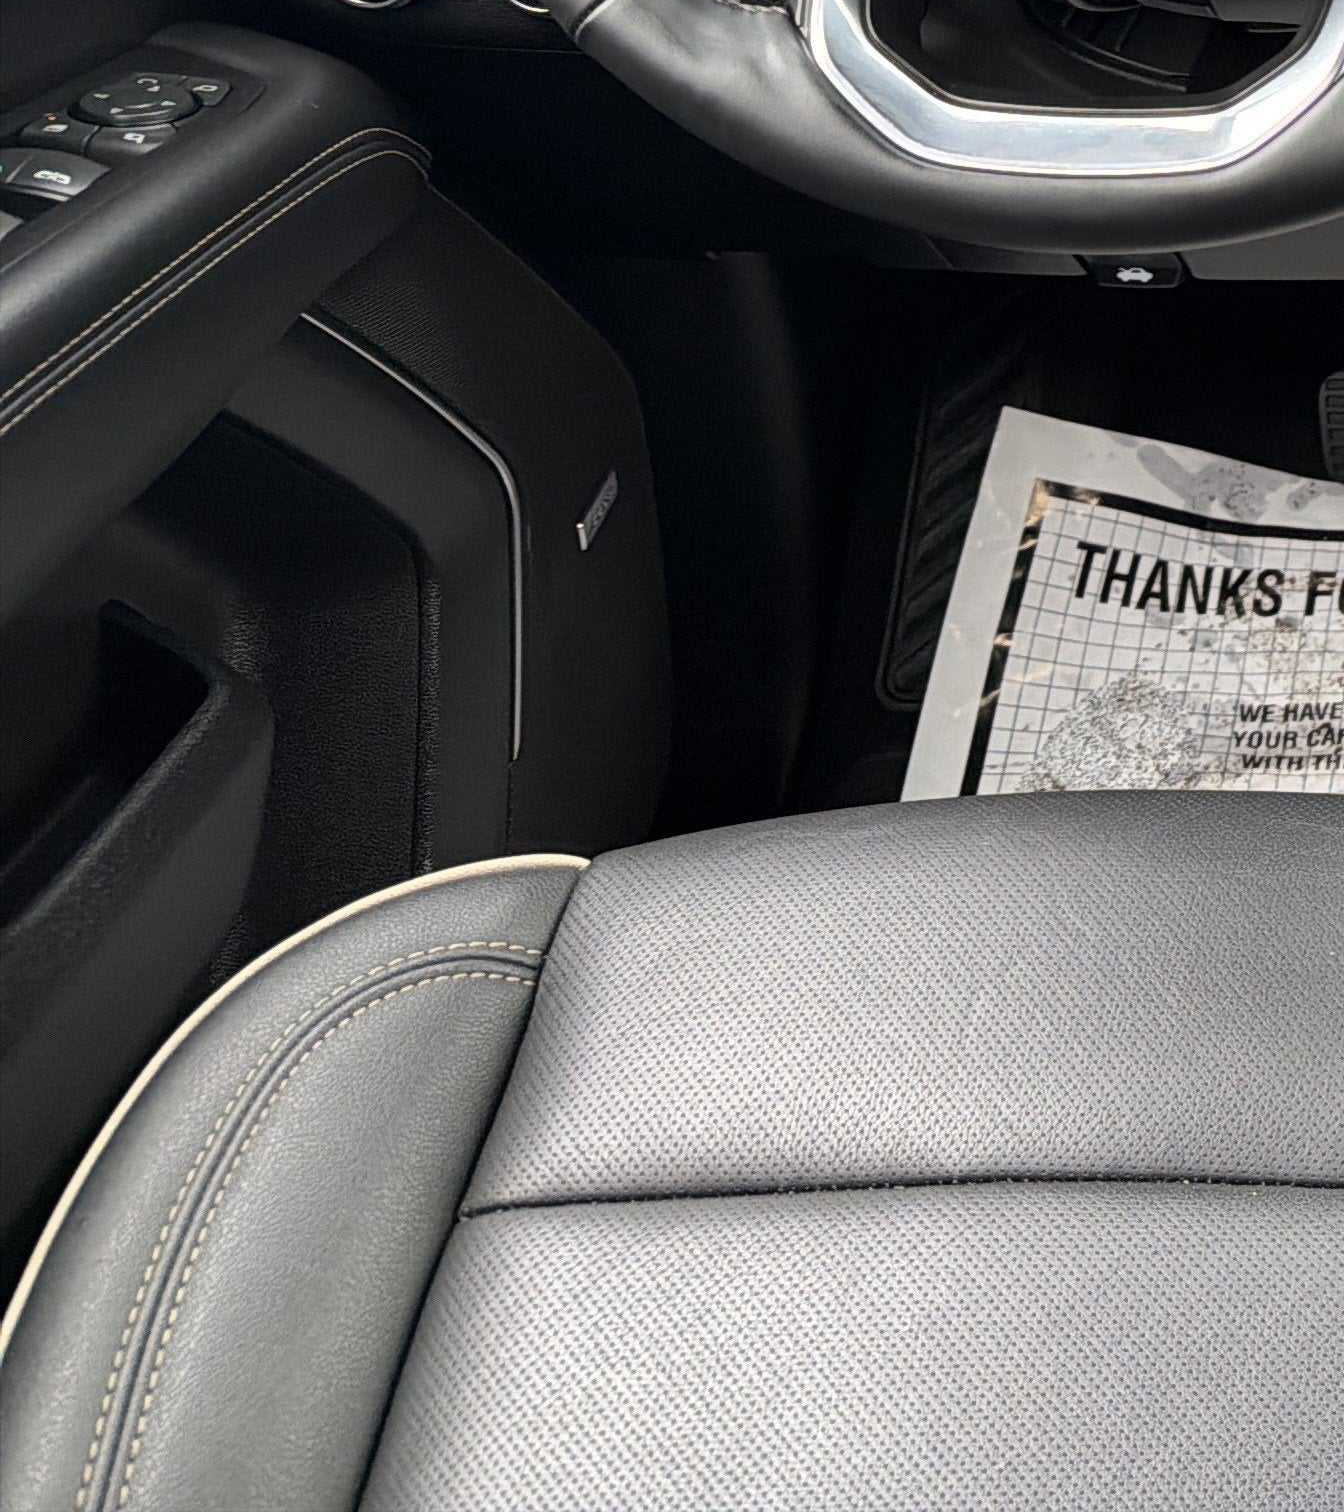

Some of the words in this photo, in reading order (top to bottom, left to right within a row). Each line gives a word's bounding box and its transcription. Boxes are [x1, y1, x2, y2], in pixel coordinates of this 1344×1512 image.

[1073, 541, 1285, 618] THANKS
[1238, 703, 1275, 724] WE
[1282, 700, 1338, 723] HAVE
[1232, 726, 1299, 748] YOUR
[1241, 751, 1305, 771] WITH
